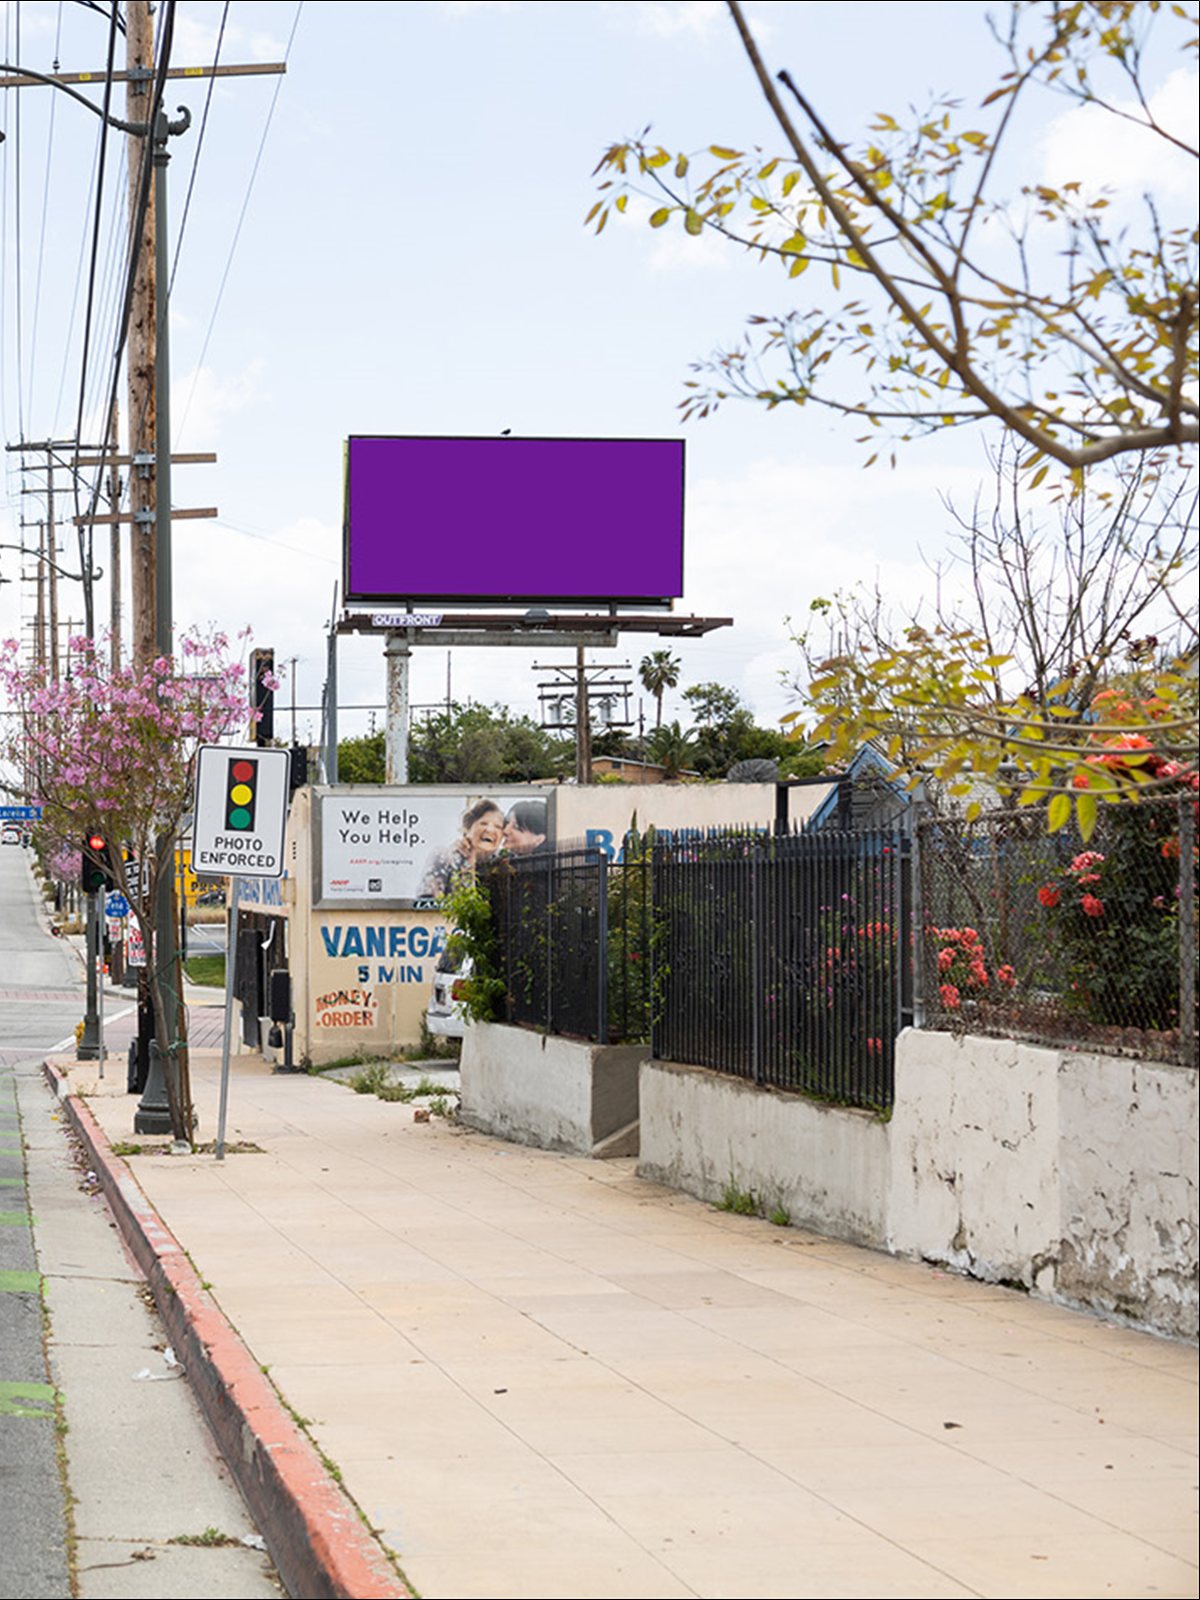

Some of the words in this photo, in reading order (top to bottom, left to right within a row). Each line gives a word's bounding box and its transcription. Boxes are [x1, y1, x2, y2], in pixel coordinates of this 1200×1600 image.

[374, 614, 440, 626] OUTFRONT
[341, 810, 371, 825] We
[378, 809, 419, 828] Help
[214, 836, 263, 852] PHOTO
[339, 829, 371, 844] You
[379, 829, 426, 847] Help.
[200, 851, 276, 868] ENFORCED
[321, 926, 464, 958] VANEGA
[358, 966, 370, 983] 5
[378, 966, 423, 983] MIN
